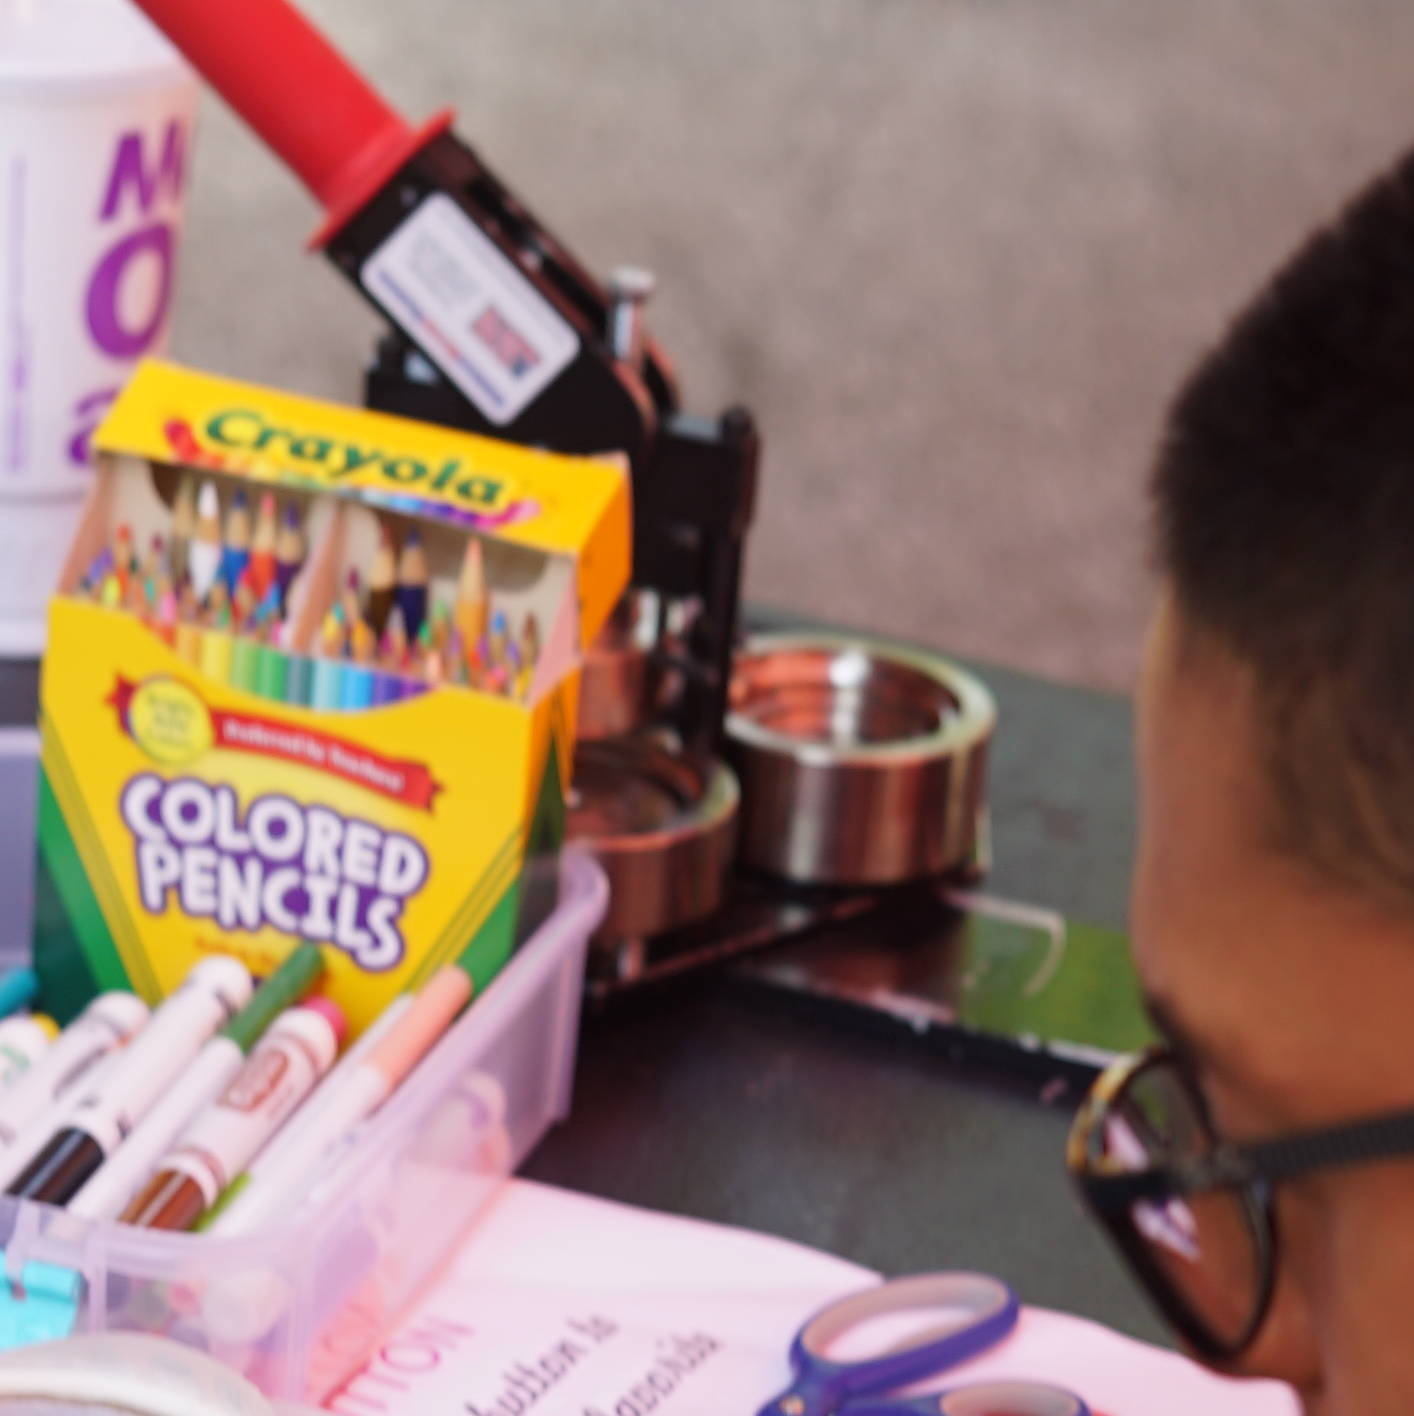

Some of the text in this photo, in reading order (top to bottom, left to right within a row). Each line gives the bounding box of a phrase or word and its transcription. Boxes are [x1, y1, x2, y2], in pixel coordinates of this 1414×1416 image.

[206, 409, 504, 504] Crayola
[121, 773, 428, 898] COLORED
[140, 841, 405, 973] PENCILS
